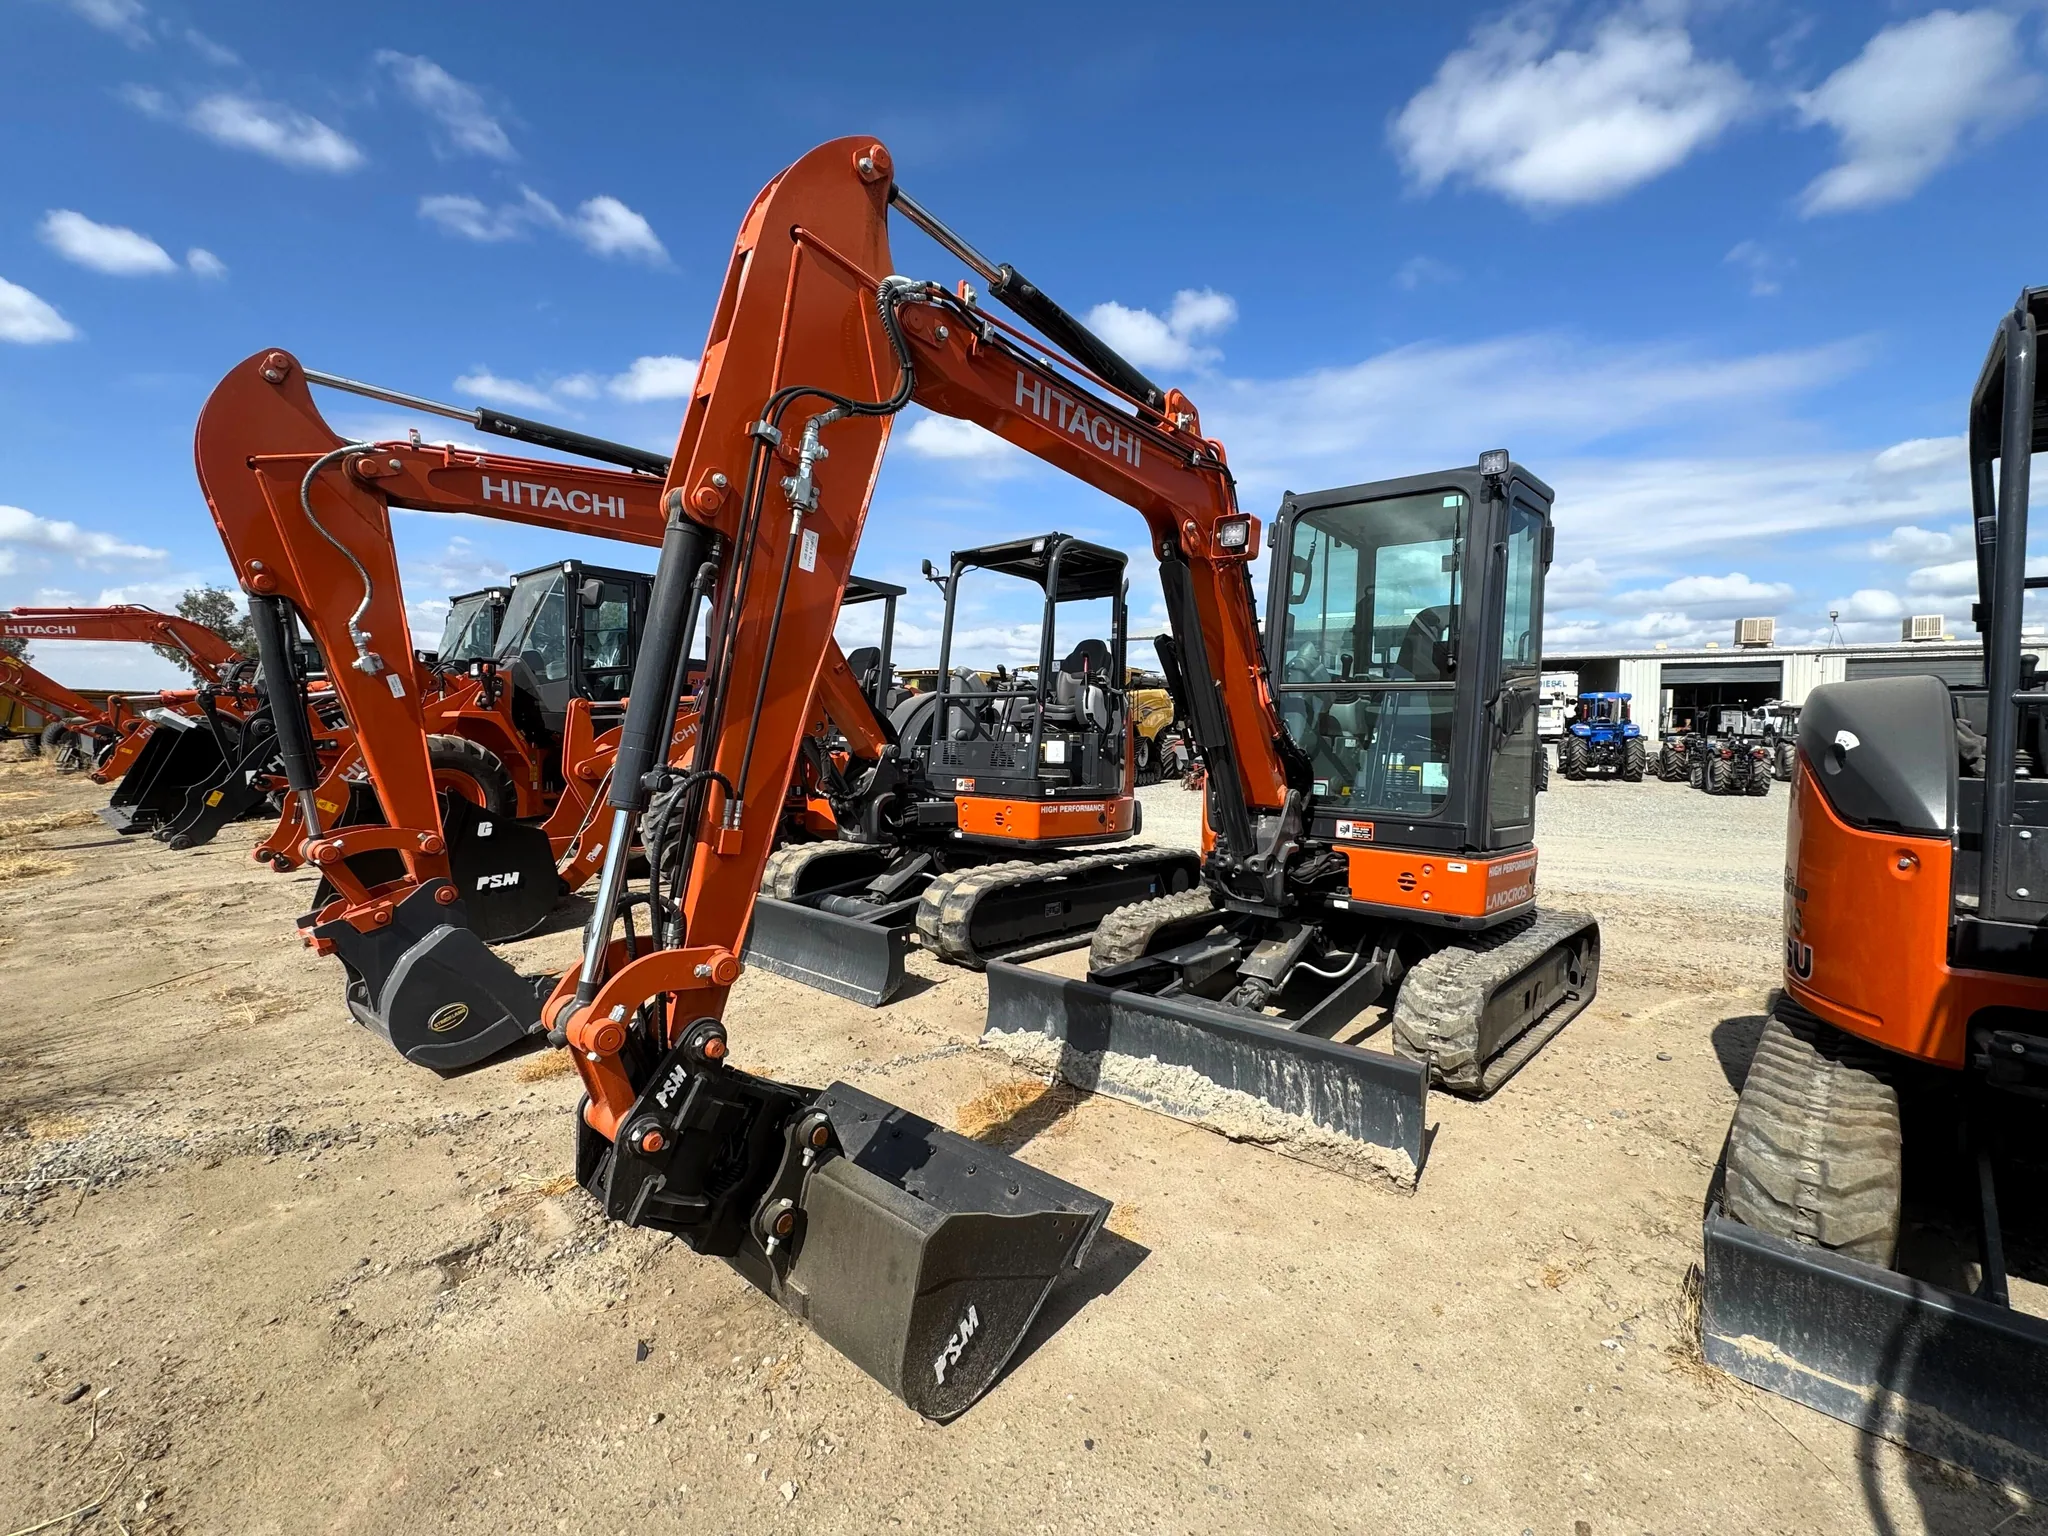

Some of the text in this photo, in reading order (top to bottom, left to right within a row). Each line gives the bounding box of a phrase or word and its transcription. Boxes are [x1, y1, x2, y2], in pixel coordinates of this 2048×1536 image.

[1015, 370, 1142, 468] HITACHI
[481, 476, 626, 520] HITACHI
[4, 625, 77, 635] HITACHI
[1040, 804, 1105, 814] HIGH PERFORMANCE
[1489, 864, 1503, 878] HIGH
